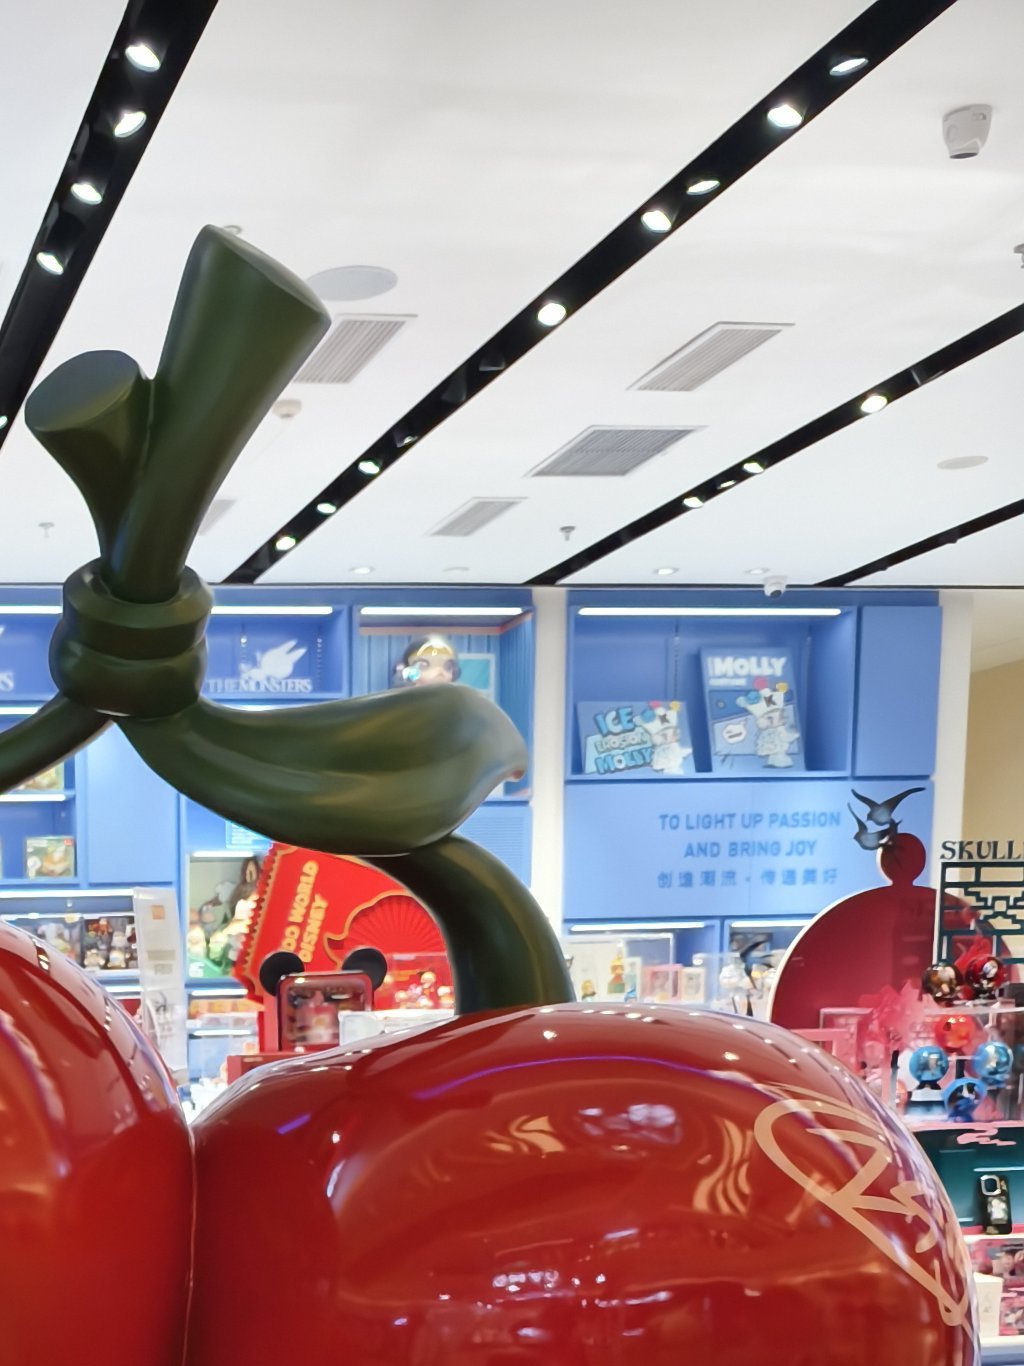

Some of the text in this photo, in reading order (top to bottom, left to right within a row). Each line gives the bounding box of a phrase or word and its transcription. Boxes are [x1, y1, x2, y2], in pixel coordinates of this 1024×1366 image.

[713, 656, 787, 677] MOLLY
[594, 706, 635, 737] ICE
[659, 811, 841, 830] TO LIGHT UP PASSION
[684, 840, 817, 858] AND BRING JOY
[940, 840, 1024, 860] SKULL
[288, 860, 319, 923] WORLD
[299, 894, 328, 963] DISNEY
